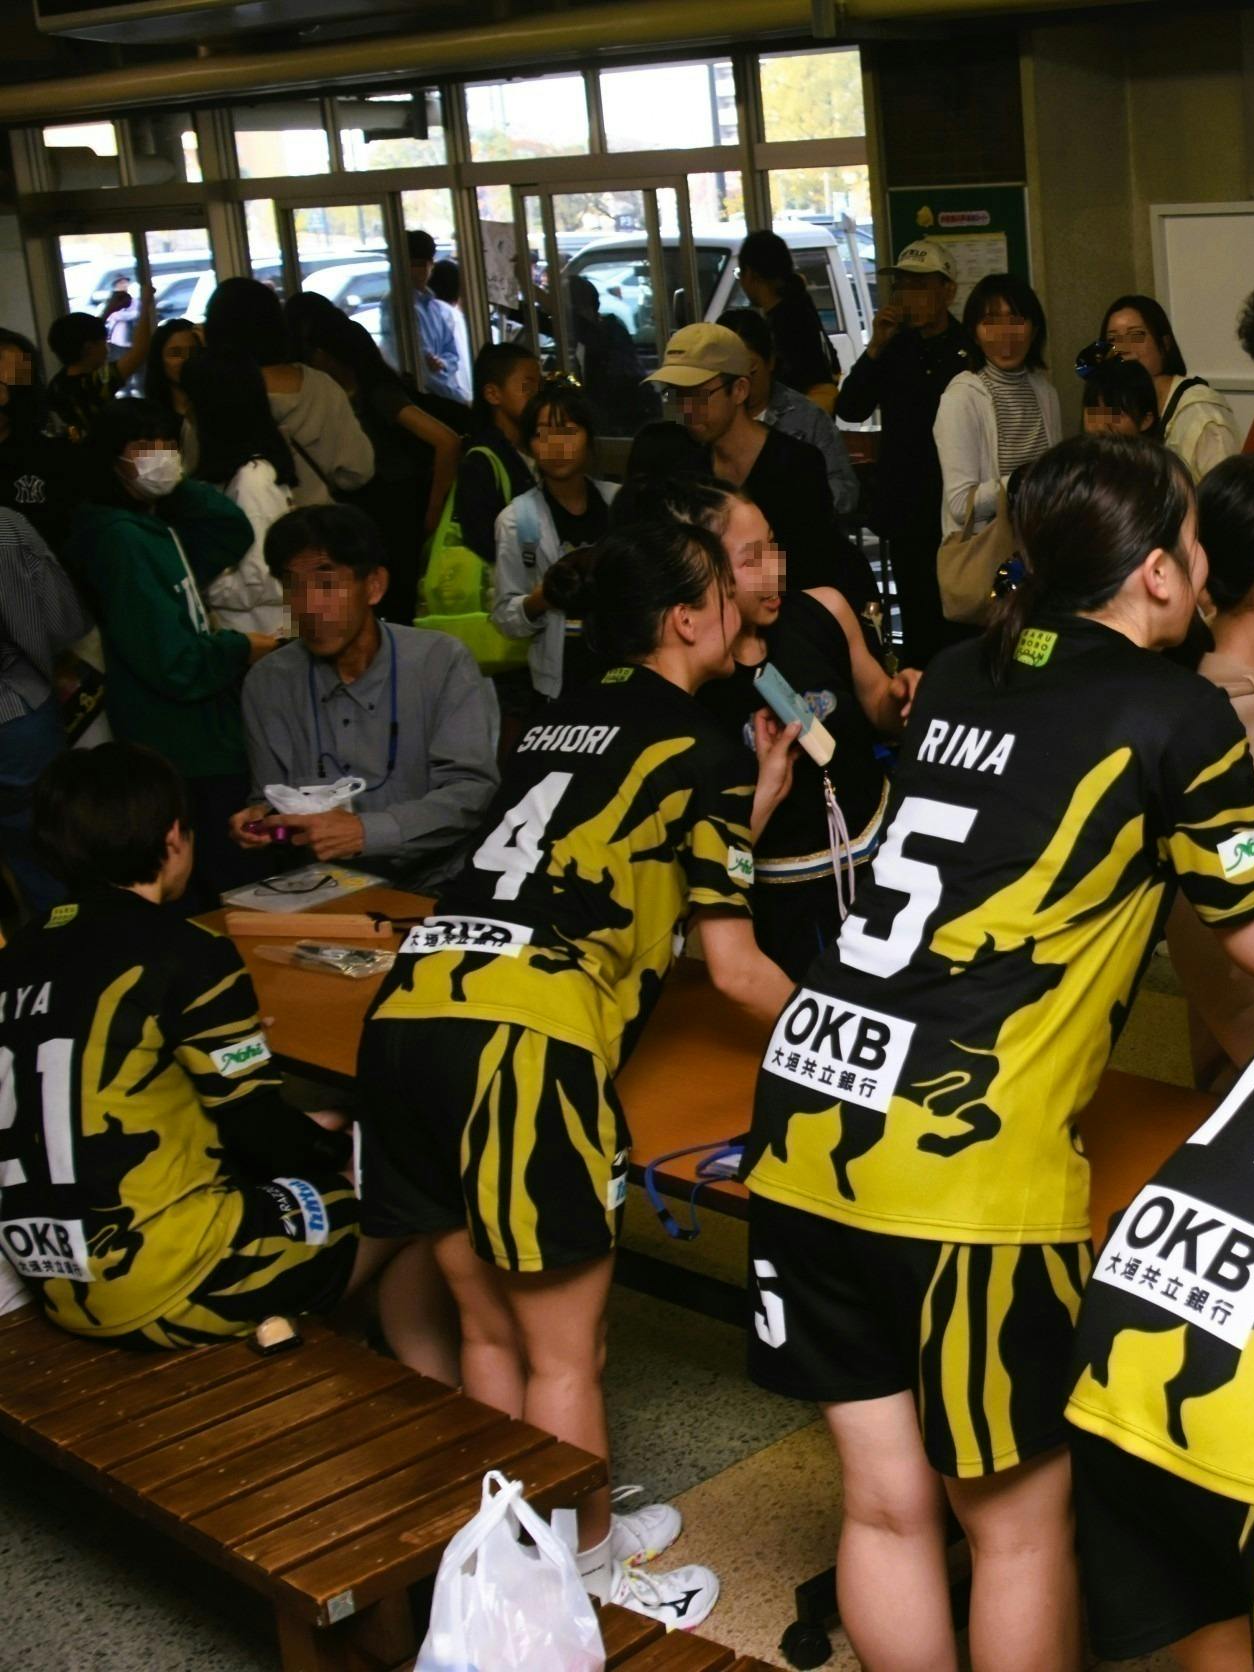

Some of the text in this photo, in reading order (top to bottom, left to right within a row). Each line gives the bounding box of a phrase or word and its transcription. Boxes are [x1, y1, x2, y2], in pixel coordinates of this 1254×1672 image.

[517, 725, 621, 755] SHIORI
[917, 719, 1016, 775] RINA
[473, 771, 574, 901] 4
[836, 797, 978, 979] 5
[784, 997, 891, 1071] OKB
[771, 1048, 878, 1098] 大垣共立銀行
[3, 1223, 74, 1260] OKB
[1105, 1252, 1234, 1326] 大垣共立銀行
